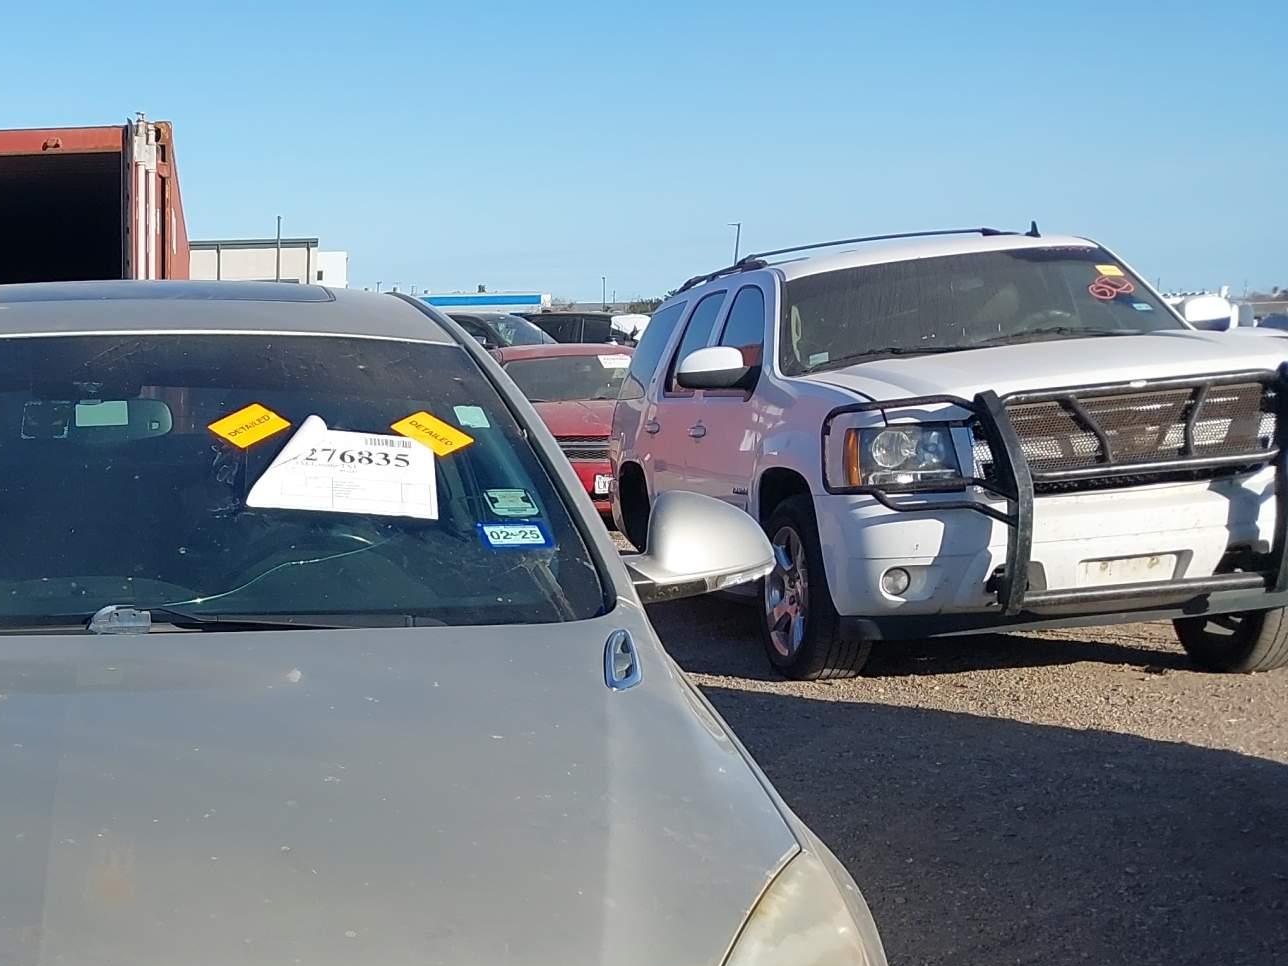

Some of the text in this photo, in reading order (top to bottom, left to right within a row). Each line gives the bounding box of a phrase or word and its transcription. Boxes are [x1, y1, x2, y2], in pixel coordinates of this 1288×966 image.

[228, 414, 271, 437] DETAILED
[409, 420, 453, 446] DETAILED
[305, 447, 410, 468] 276835
